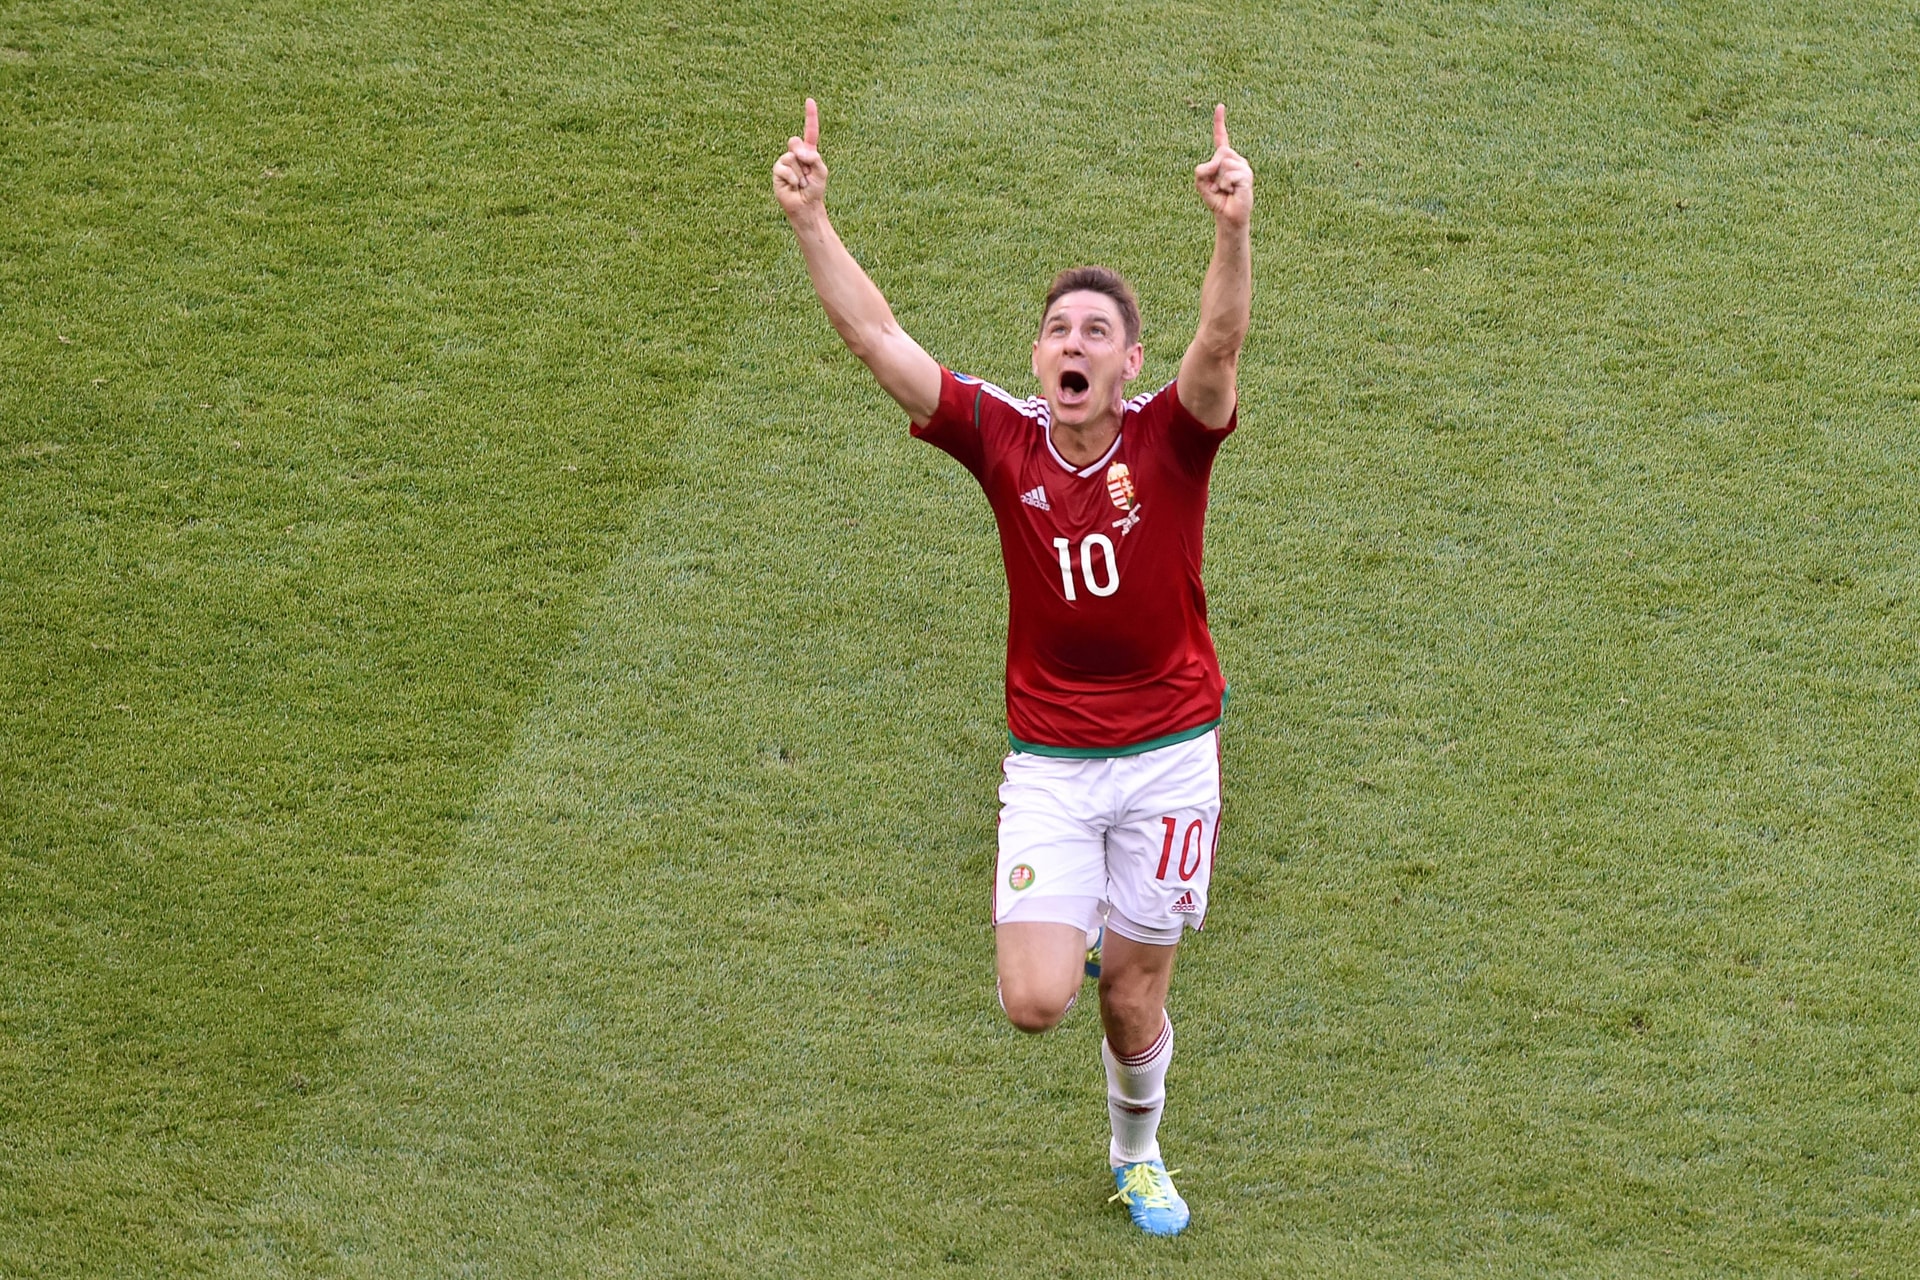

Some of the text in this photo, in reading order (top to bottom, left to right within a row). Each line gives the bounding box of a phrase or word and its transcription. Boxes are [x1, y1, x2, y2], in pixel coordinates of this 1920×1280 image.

[1020, 494, 1051, 511] adidas
[1053, 533, 1120, 601] 10
[1155, 816, 1203, 881] 10
[1171, 903, 1196, 912] adidas
